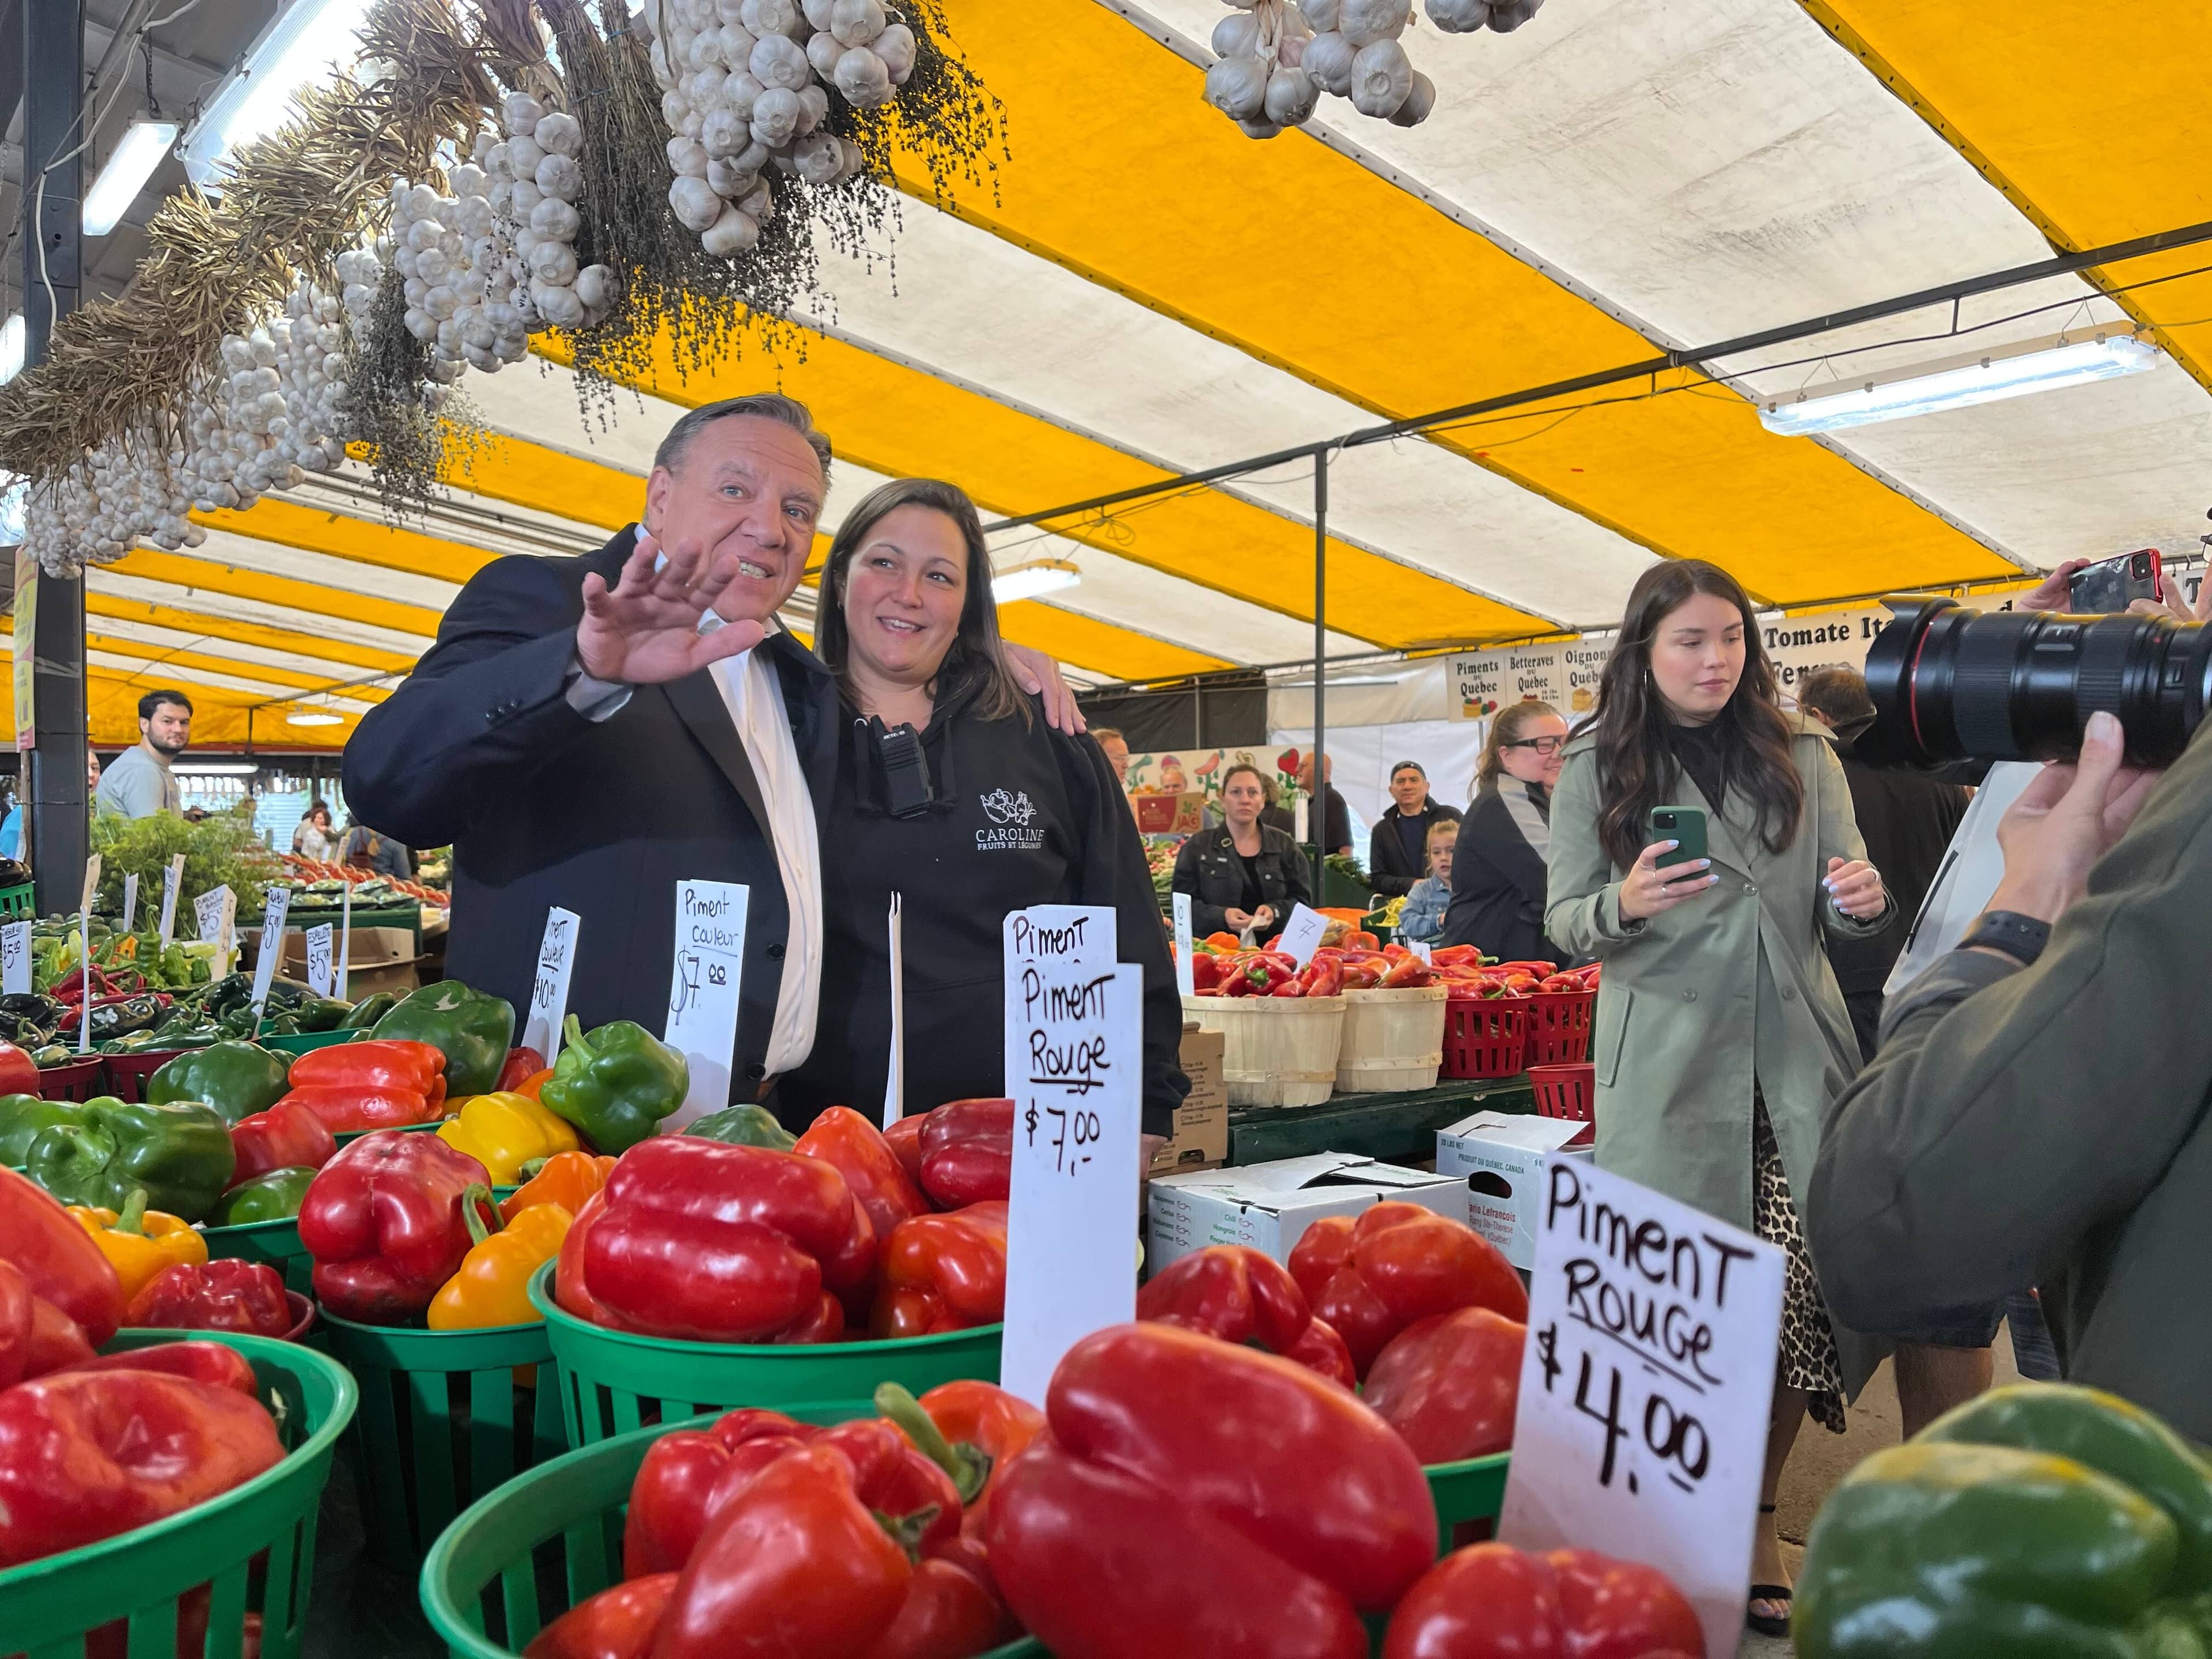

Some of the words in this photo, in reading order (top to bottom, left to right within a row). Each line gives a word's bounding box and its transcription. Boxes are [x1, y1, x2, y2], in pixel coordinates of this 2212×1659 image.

[1765, 622, 1849, 648] Tomate
[1510, 655, 1554, 669] Betteraves
[1566, 650, 1609, 666] Oignon
[1457, 661, 1498, 675] Piments
[1461, 683, 1497, 696] Québec
[1518, 676, 1548, 692] Québec
[976, 828, 1044, 842] CAROLINE
[978, 842, 1006, 850] FRUITS
[685, 889, 730, 917] Piment
[1030, 1030, 1110, 1094] Rouge
[1459, 1154, 1477, 1164] PRODUIT
[1506, 1164, 1525, 1175] CANADA
[1469, 1202, 1480, 1214] ario
[1483, 1206, 1516, 1222] Lefrancois
